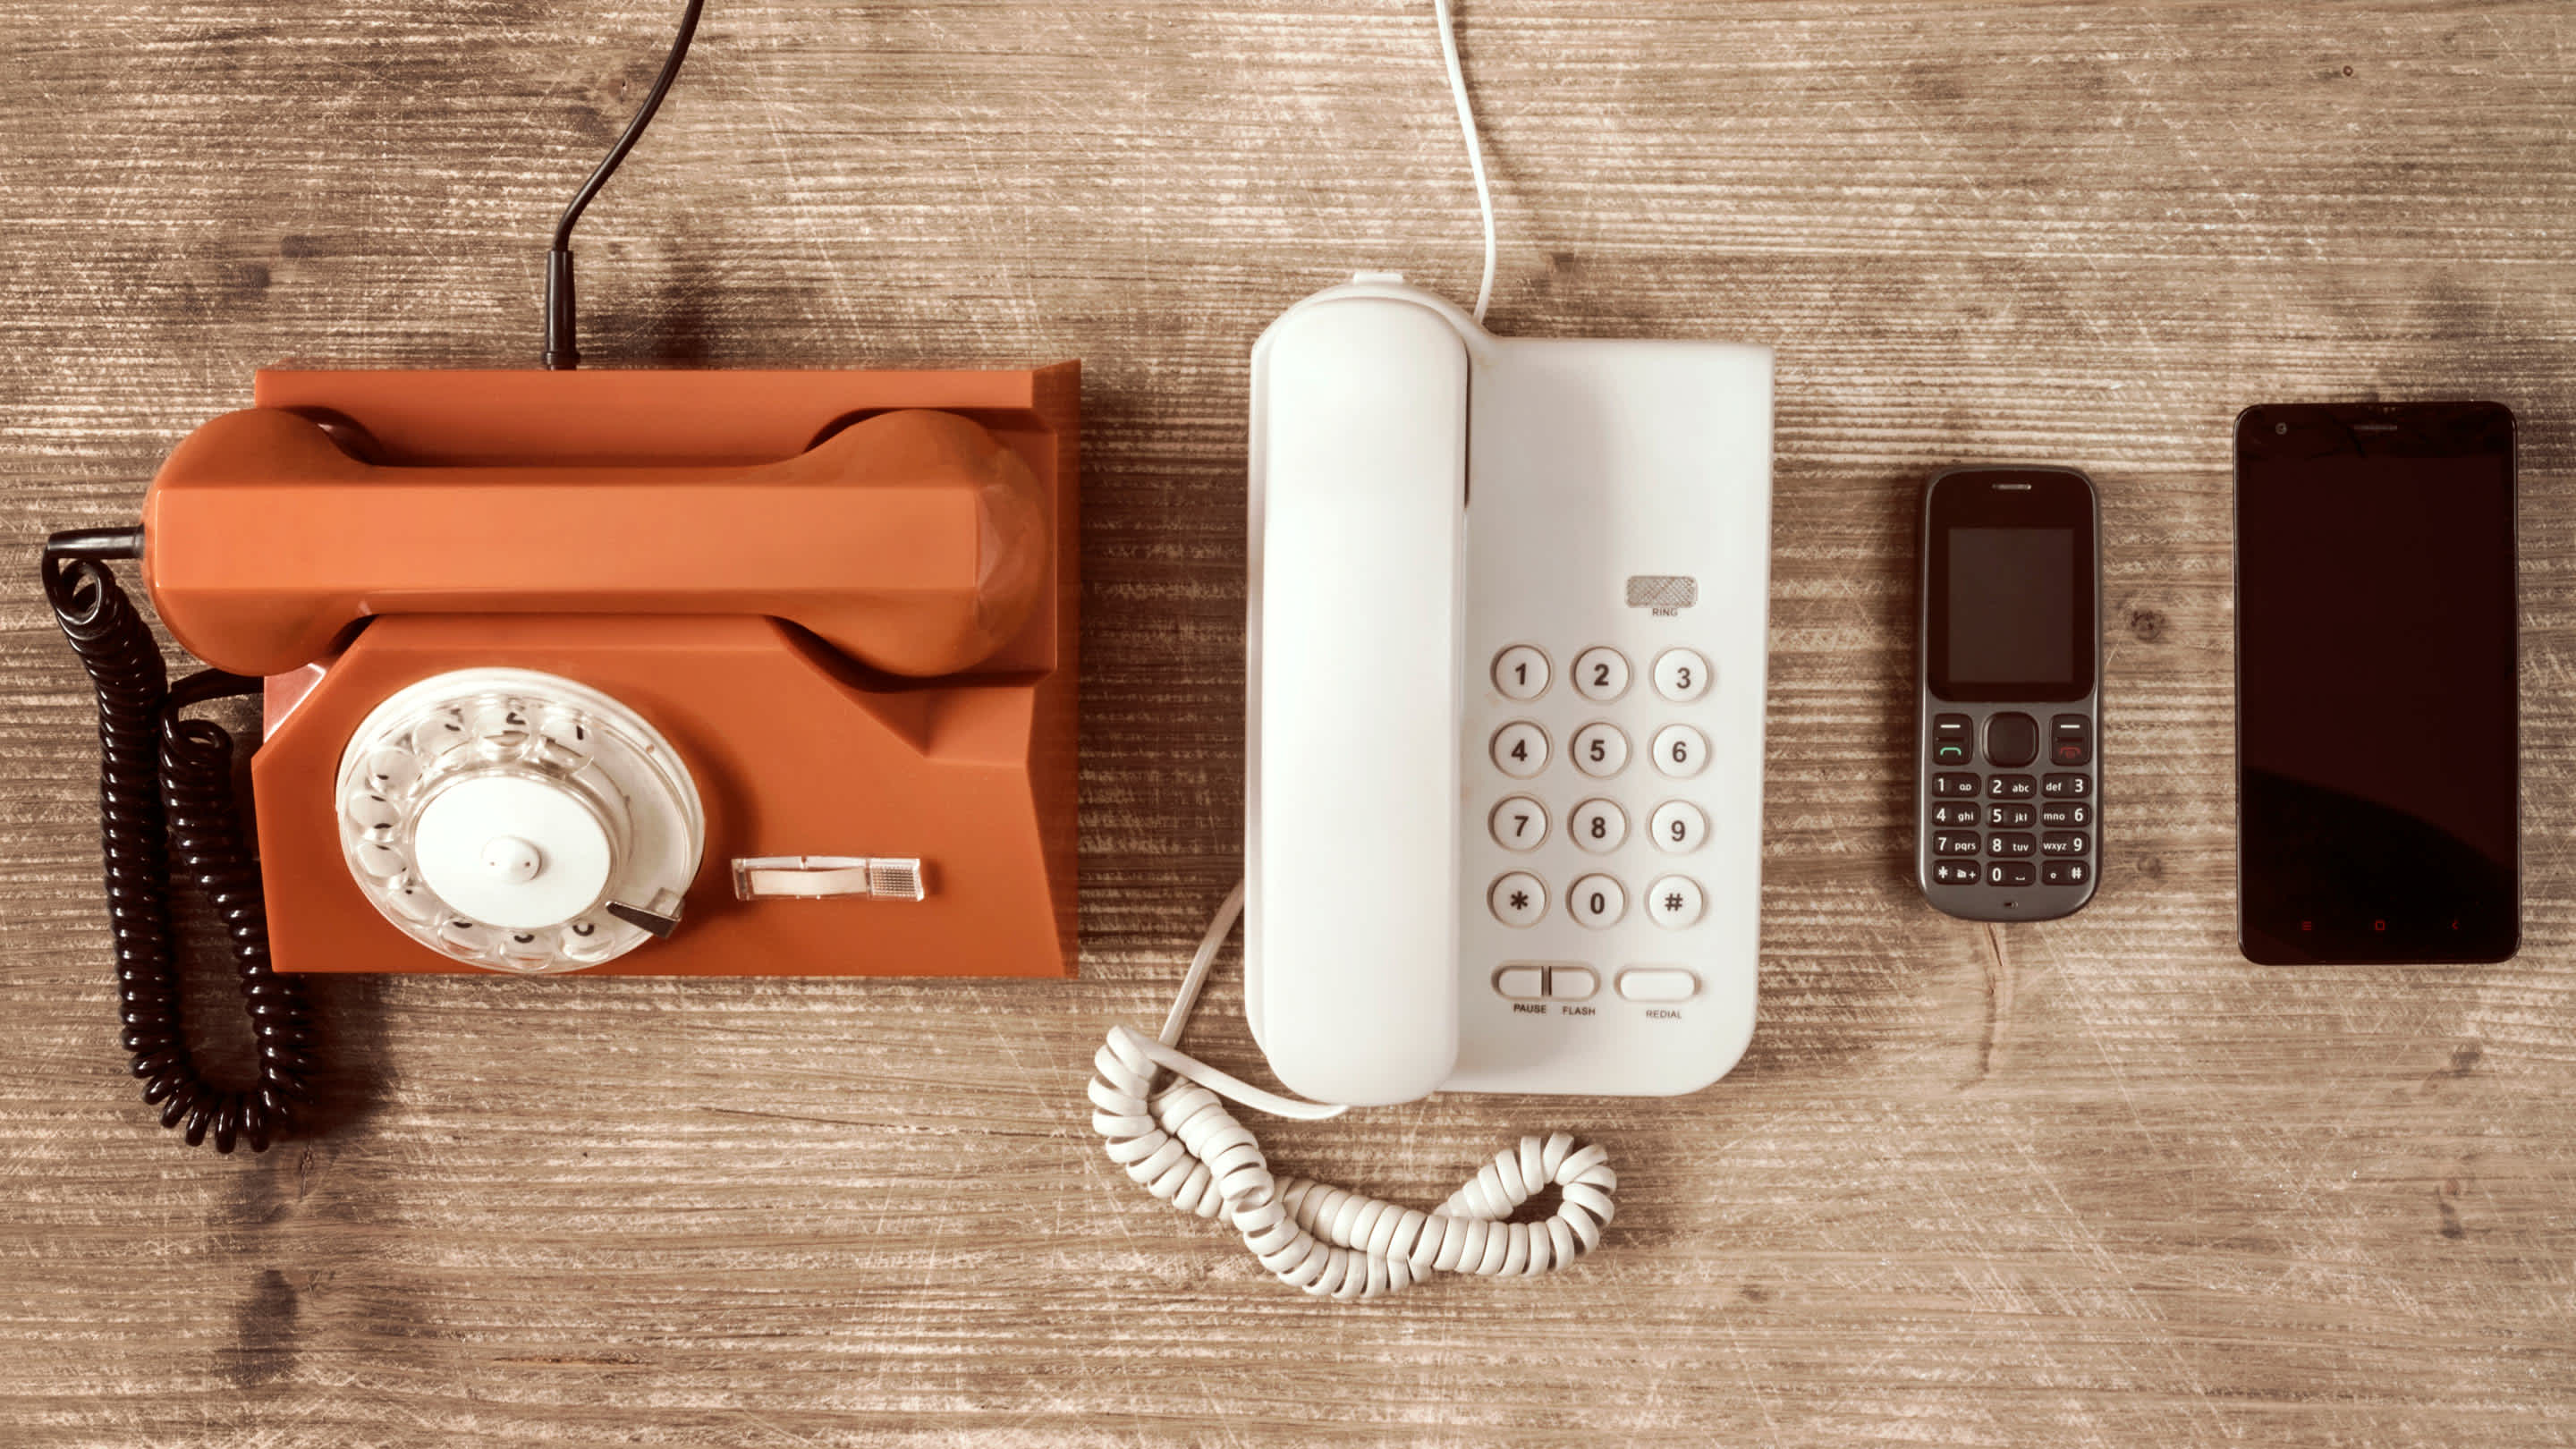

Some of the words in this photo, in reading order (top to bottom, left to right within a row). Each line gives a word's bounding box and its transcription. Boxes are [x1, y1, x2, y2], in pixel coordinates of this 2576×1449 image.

[1652, 608, 1678, 617] RING
[1514, 663, 1527, 686] 1
[1593, 663, 1609, 687] 2
[1675, 666, 1691, 690] 3
[1511, 739, 1528, 762] 4
[1589, 739, 1606, 762] 5
[1672, 741, 1687, 763] 6
[1936, 777, 1945, 792] 1
[1992, 779, 2003, 794] 2
[2012, 783, 2030, 793] abc
[2046, 782, 2063, 792] def
[2074, 778, 2085, 793] 3
[1936, 808, 1947, 823] 4
[1957, 811, 1975, 823] ghi
[1992, 809, 2003, 824] 5
[2014, 812, 2029, 824] jkl
[2043, 812, 2066, 822] mno
[2073, 808, 2085, 823] 6
[1513, 815, 1530, 837] 7
[1590, 816, 1606, 839] 8
[1671, 819, 1686, 843] 9
[1937, 836, 1948, 852] 7
[1954, 842, 1977, 852] pqrs
[1992, 838, 2003, 852] 8
[2012, 843, 2029, 852] tuv
[2043, 842, 2068, 852] wxyz
[2072, 837, 2084, 852] 9
[1992, 867, 2003, 882] 0
[2071, 866, 2083, 880] #
[1589, 892, 1606, 915] 0
[1665, 893, 1684, 912] #
[1513, 1003, 1547, 1015] PAUSE
[1562, 1005, 1597, 1017] FLASH
[1645, 1009, 1682, 1020] REDIAL
